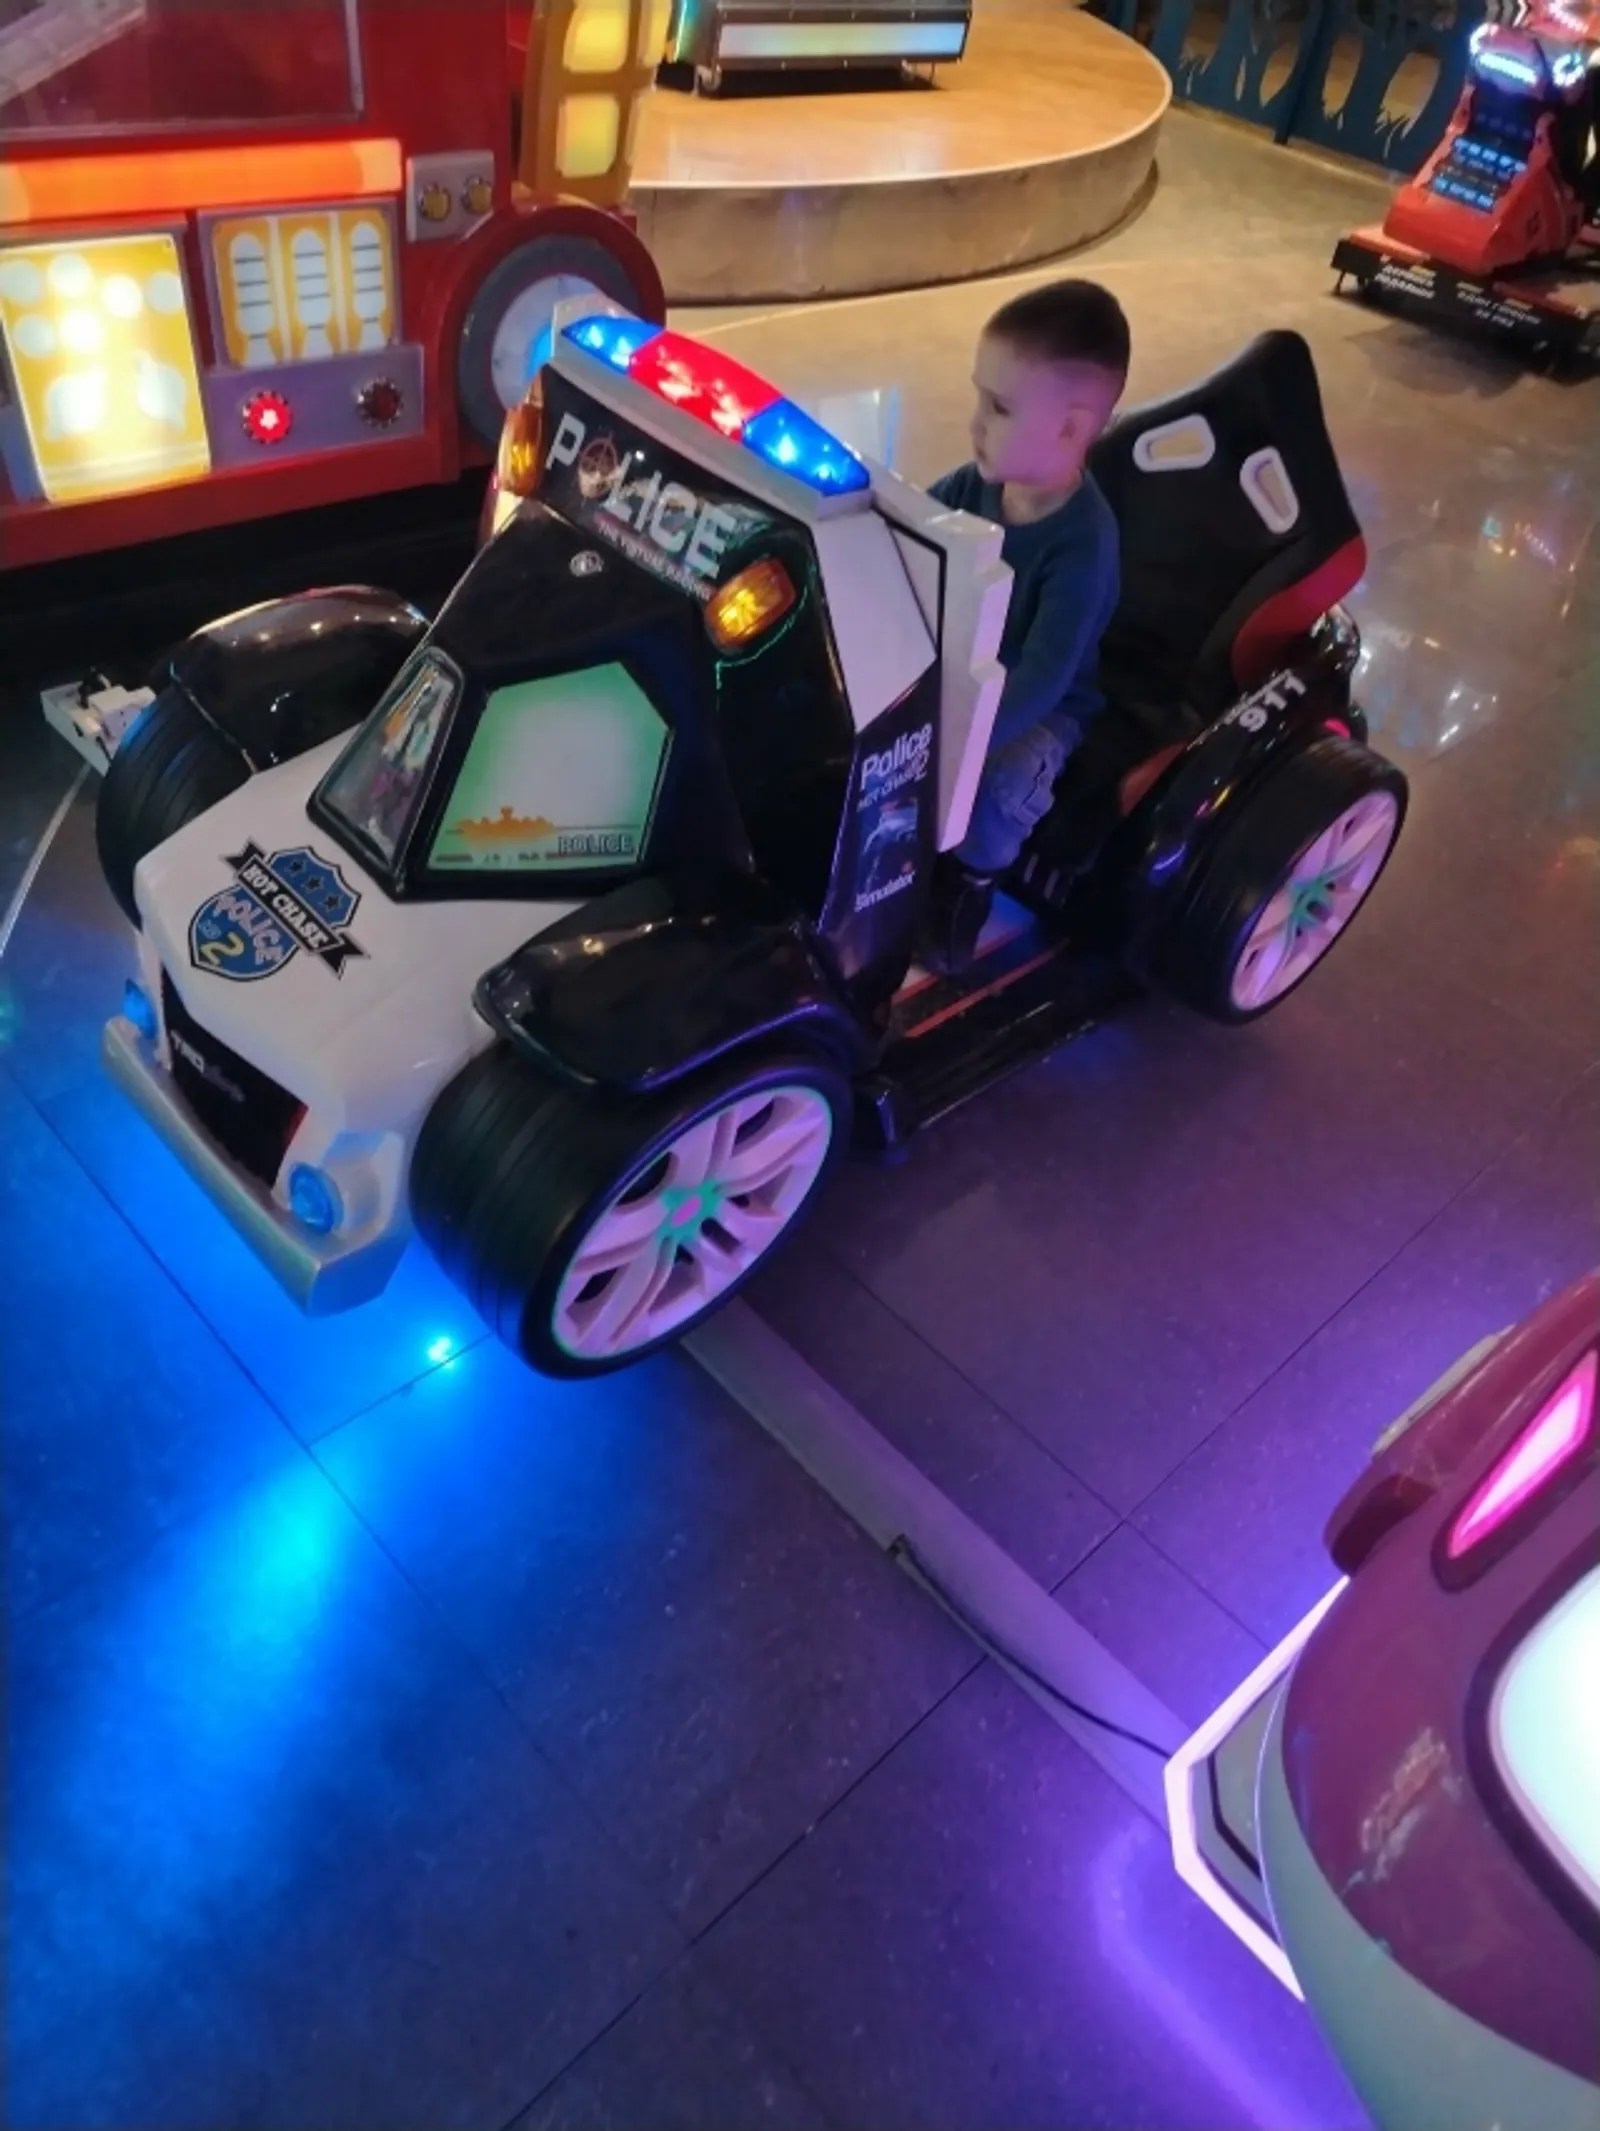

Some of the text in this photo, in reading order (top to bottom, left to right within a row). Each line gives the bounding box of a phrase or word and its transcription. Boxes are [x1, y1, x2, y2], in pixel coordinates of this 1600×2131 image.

[1238, 674, 1306, 733] 911
[859, 722, 933, 792] Police
[558, 833, 636, 856] POLICE
[212, 892, 284, 965] POLICE
[242, 864, 330, 950] HOT CHASE
[200, 931, 245, 966] 2
